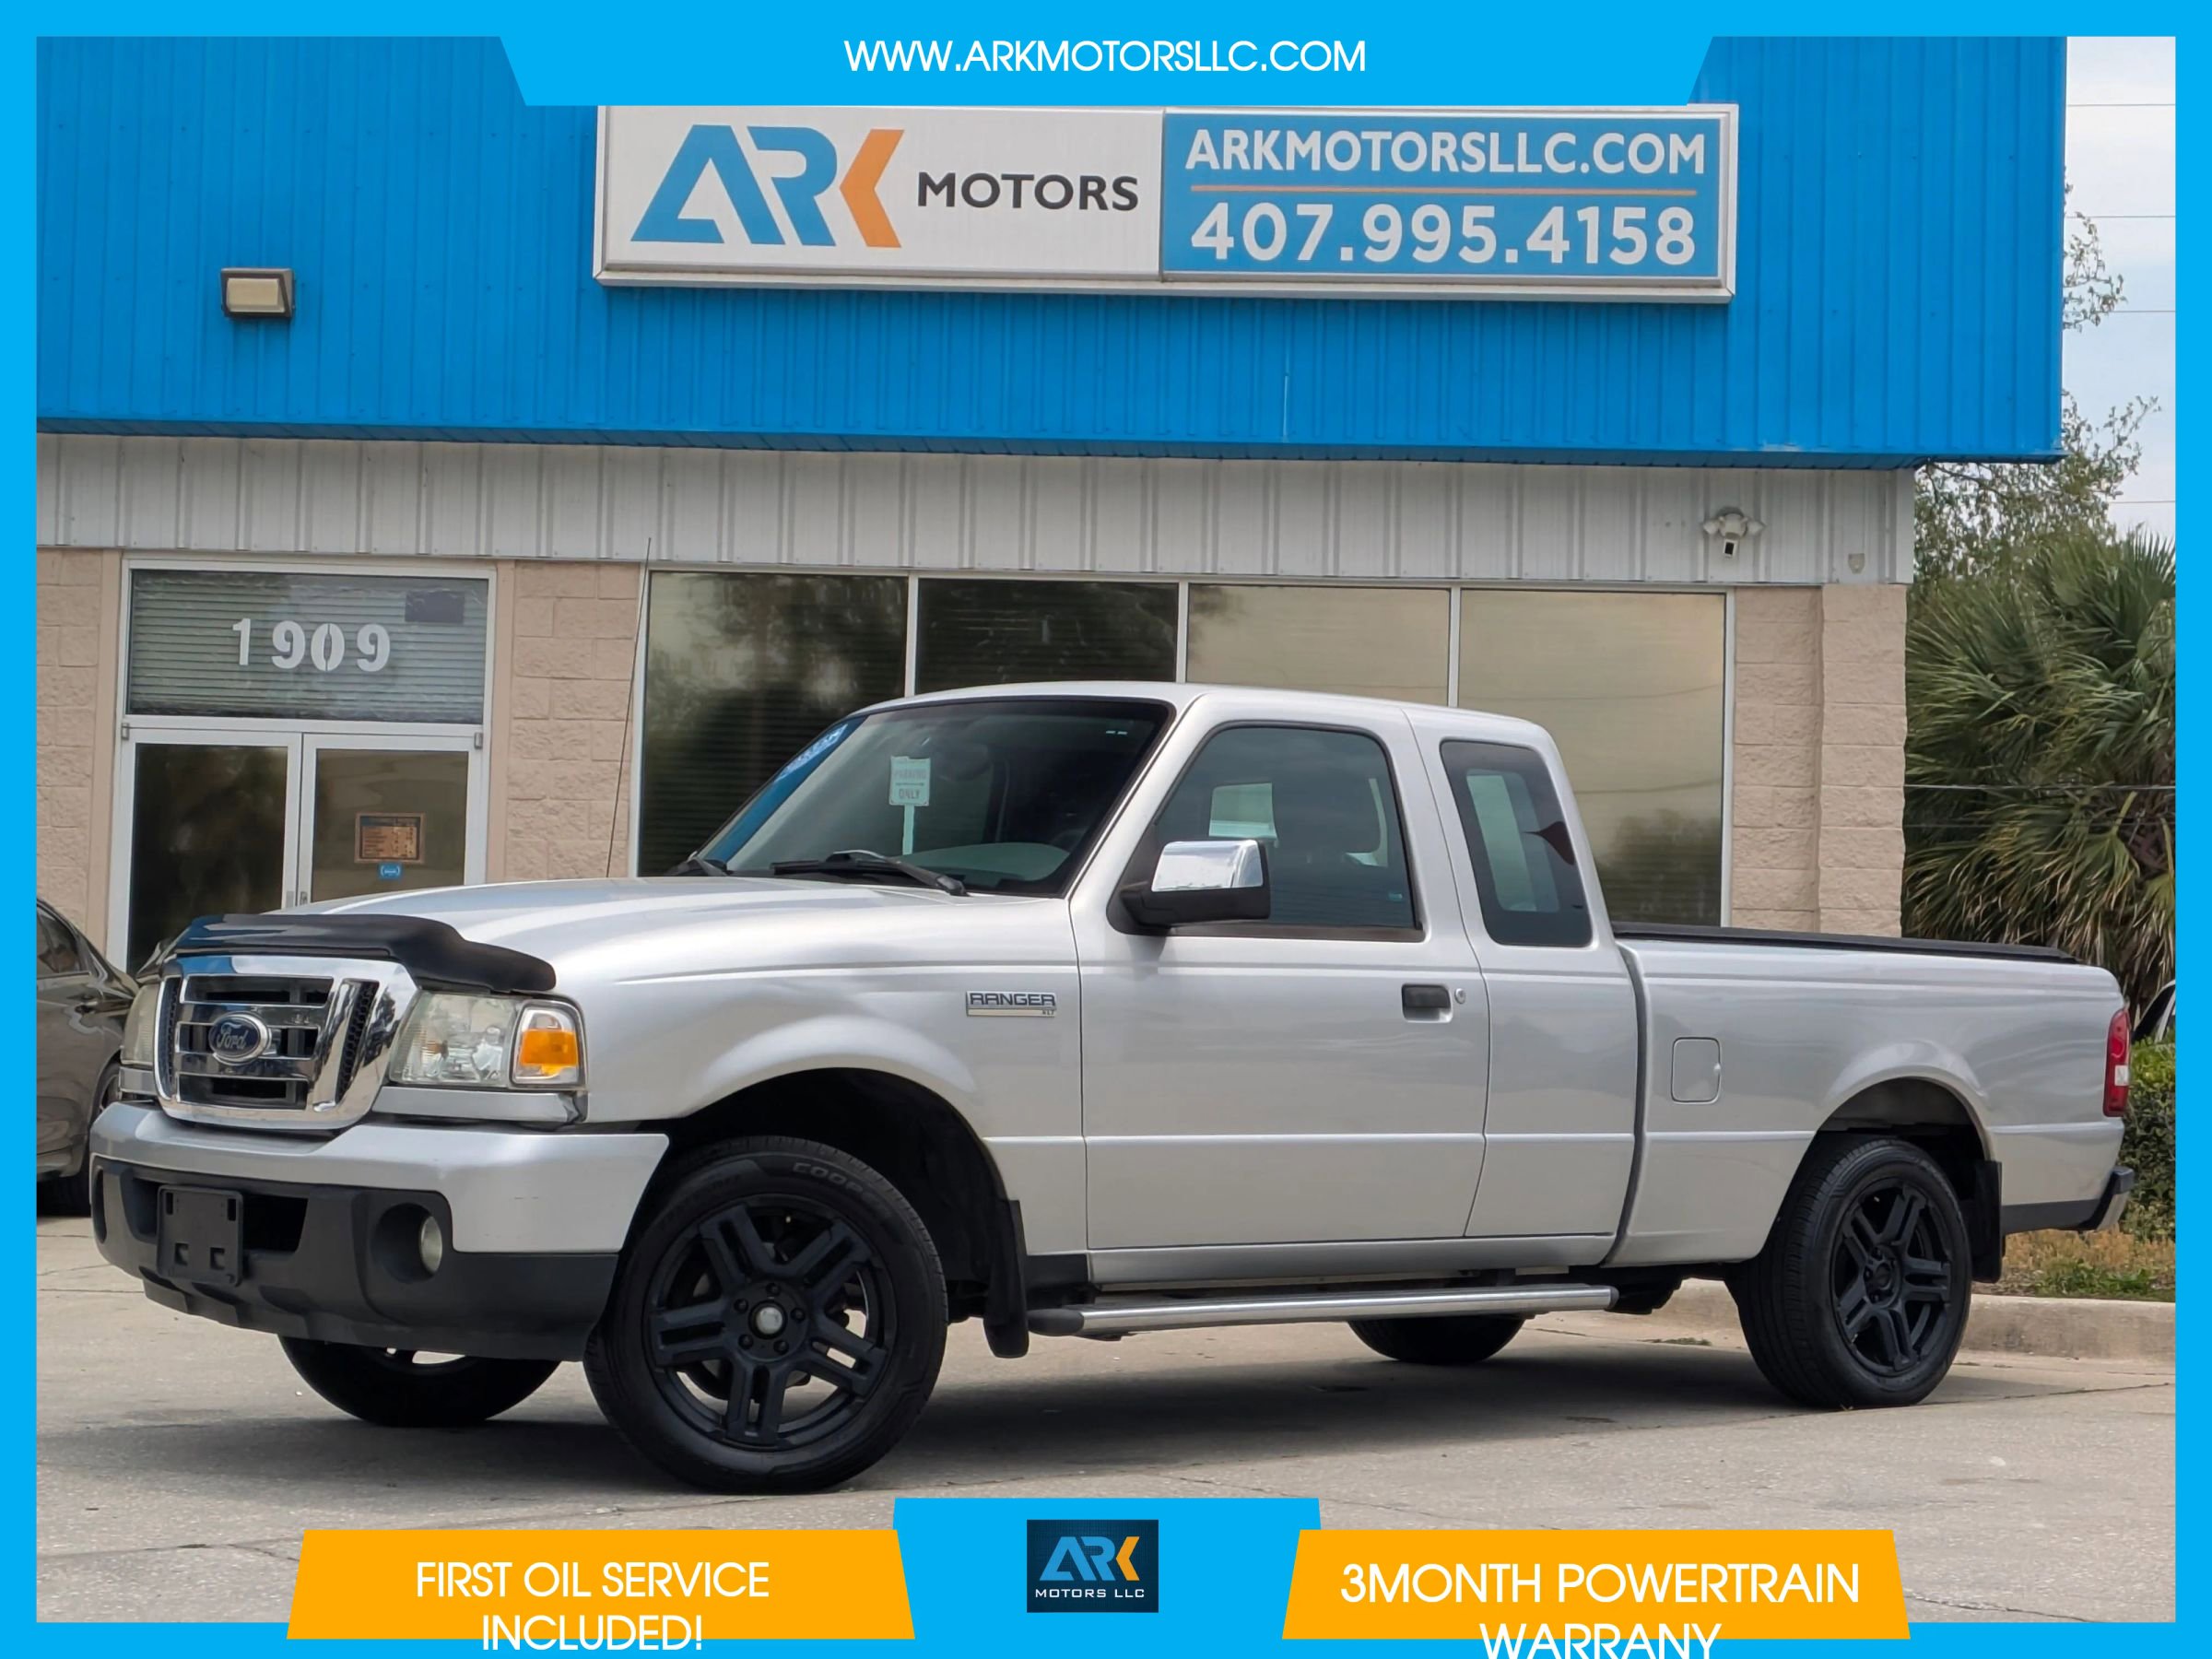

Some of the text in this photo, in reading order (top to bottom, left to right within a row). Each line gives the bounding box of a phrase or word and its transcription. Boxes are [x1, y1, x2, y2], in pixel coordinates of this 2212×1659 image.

[1185, 128, 1706, 175] ARKMOTORSLLC.COM
[630, 124, 904, 248] ARK
[917, 171, 1139, 211] MOTORS
[1191, 202, 1696, 266] 407.995.4158
[232, 618, 391, 672] 1909
[970, 993, 1055, 1006] RANGER
[217, 1022, 249, 1050] Ford
